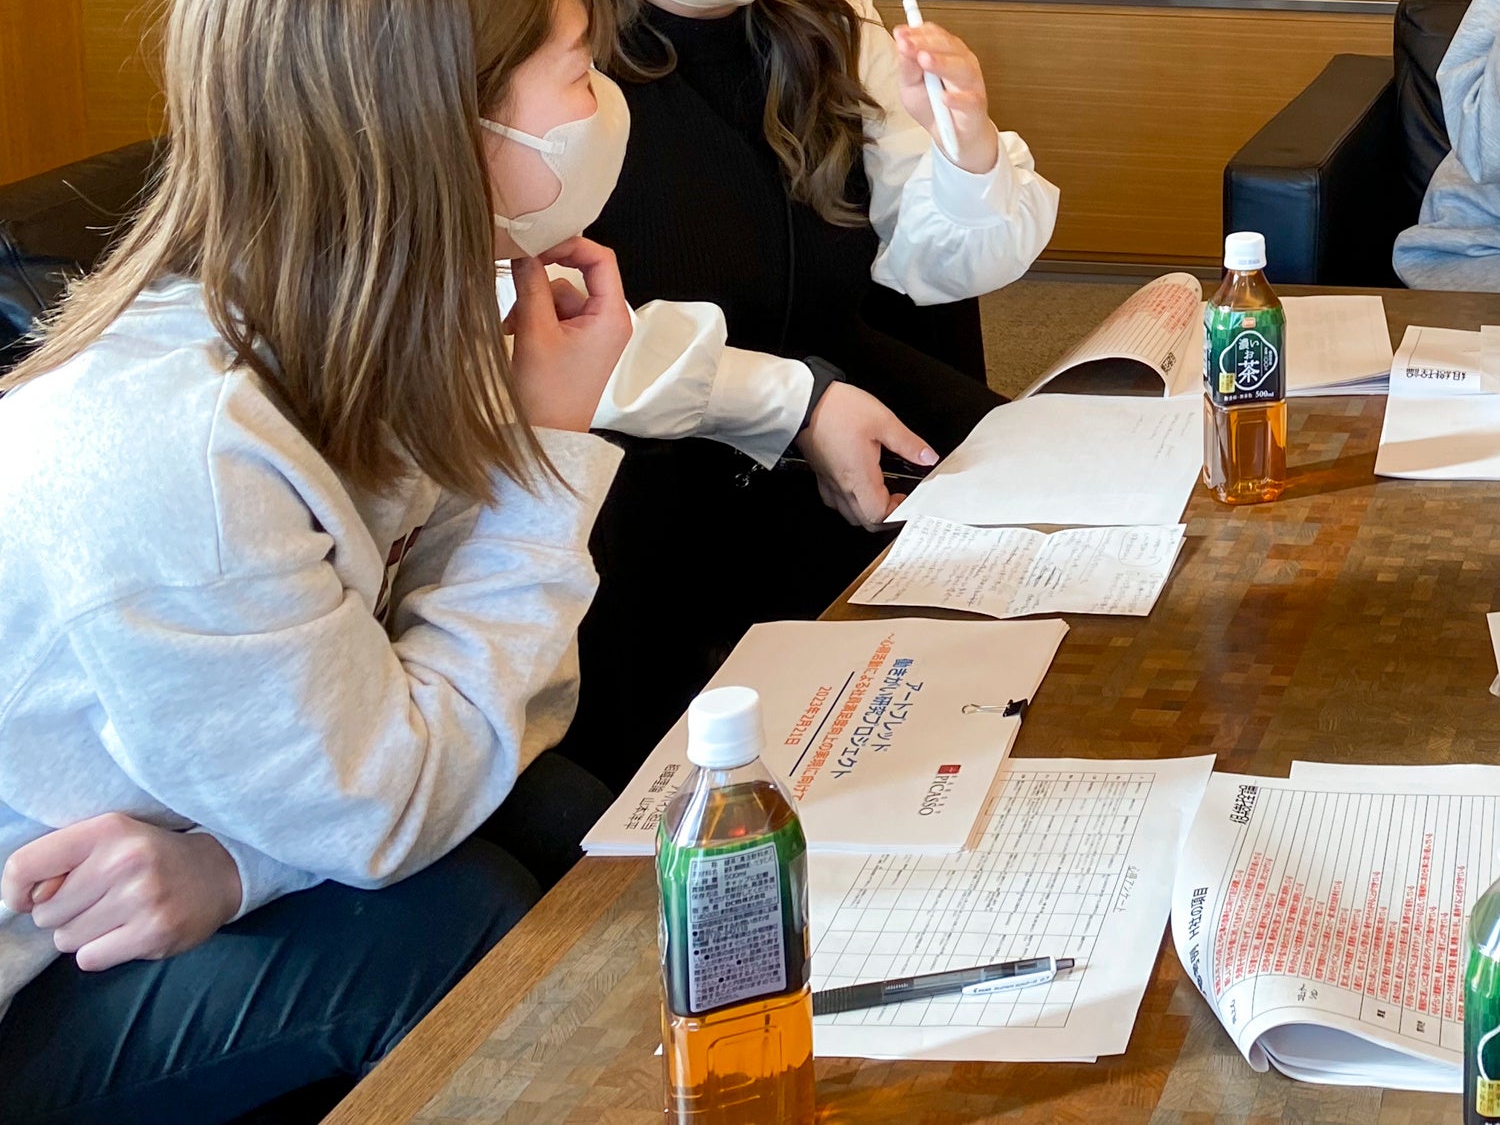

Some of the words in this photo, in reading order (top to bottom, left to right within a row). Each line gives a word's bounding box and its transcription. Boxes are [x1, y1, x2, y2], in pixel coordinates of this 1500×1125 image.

[783, 686, 833, 746] 2023年2月21日
[830, 658, 914, 779] 働きがい研究プロジェクト
[918, 776, 950, 816] PICASSO
